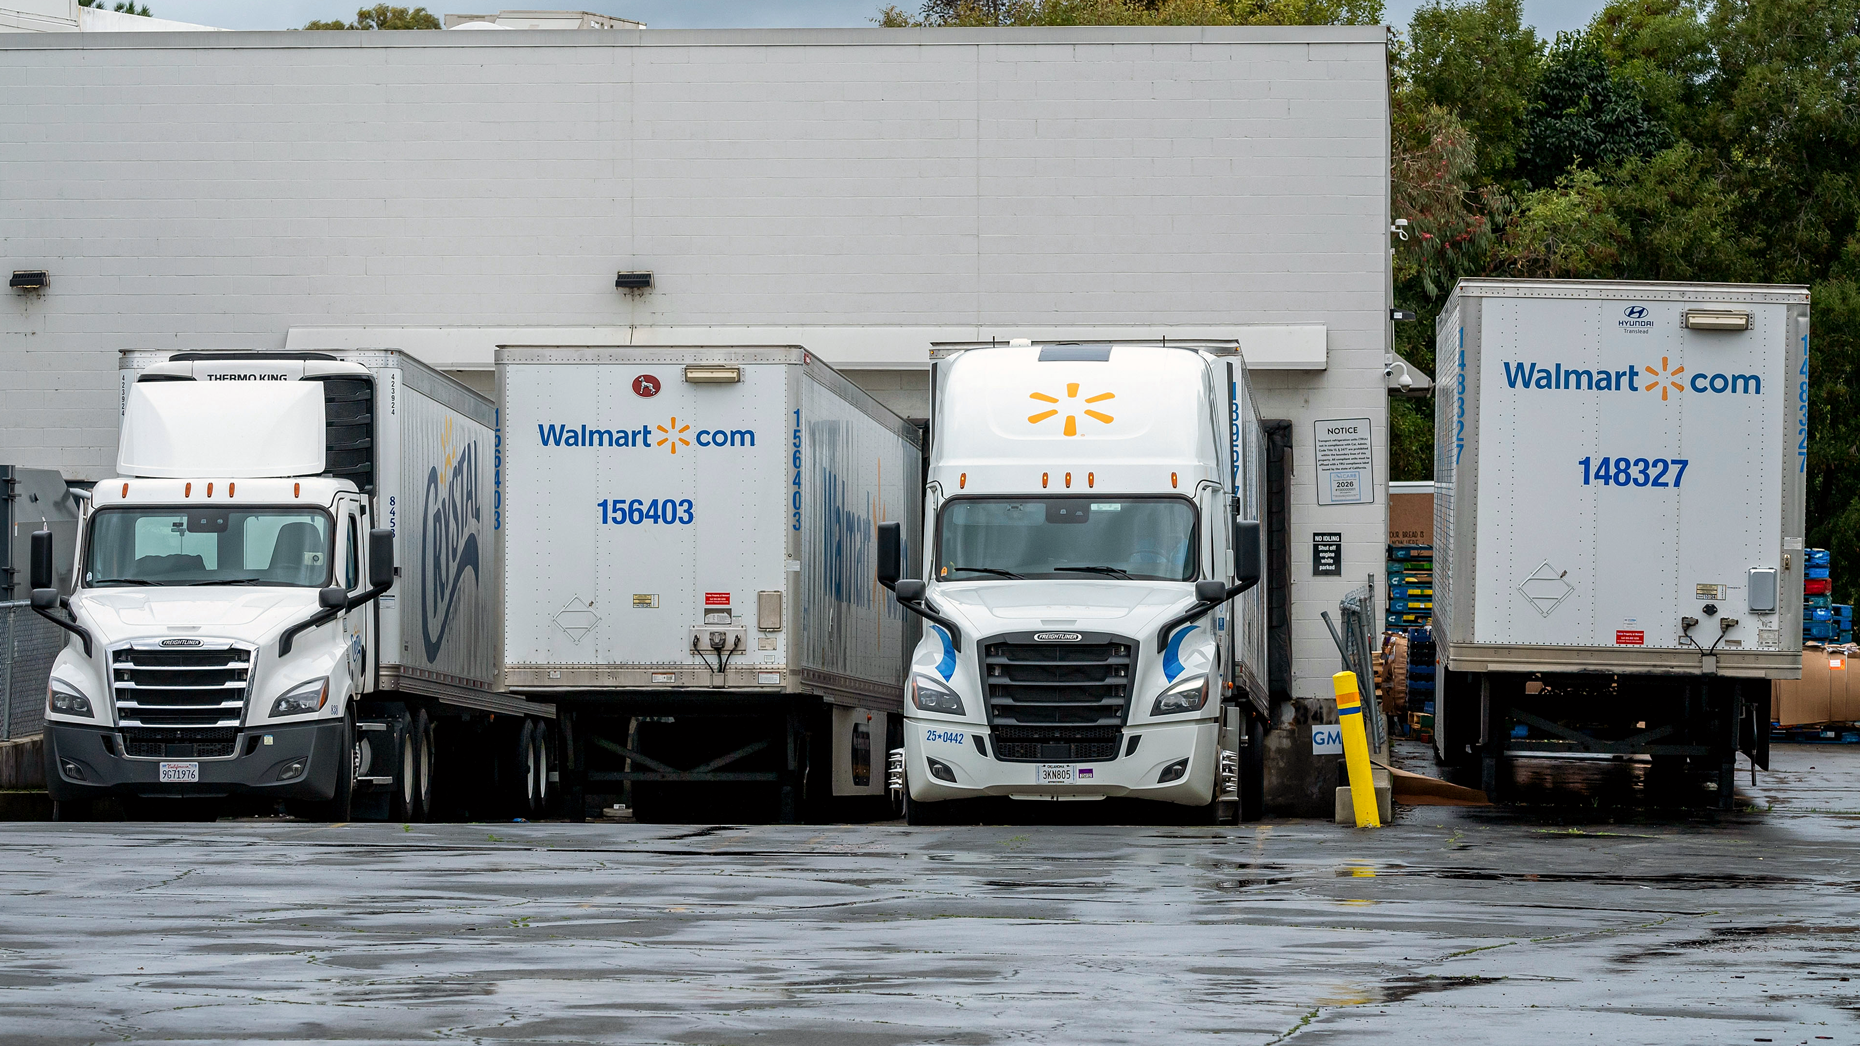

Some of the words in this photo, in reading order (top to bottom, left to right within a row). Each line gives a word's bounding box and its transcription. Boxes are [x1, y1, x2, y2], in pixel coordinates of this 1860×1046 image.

[1503, 362, 1639, 392] Walmart
[1690, 373, 1761, 395] com
[1456, 326, 1466, 465] 148327
[1797, 334, 1808, 473] 148327
[538, 424, 652, 447] Walmart
[696, 429, 755, 447] com
[1327, 427, 1358, 435] NOTICE
[494, 407, 502, 530] 156403
[792, 409, 801, 531] 156403
[1578, 456, 1689, 487] 148327
[597, 499, 694, 525] 156403
[421, 439, 480, 665] CRYSTAL
[1313, 730, 1342, 746] GM
[162, 769, 196, 780] 9G71976
[1042, 770, 1071, 780] 3KN805
